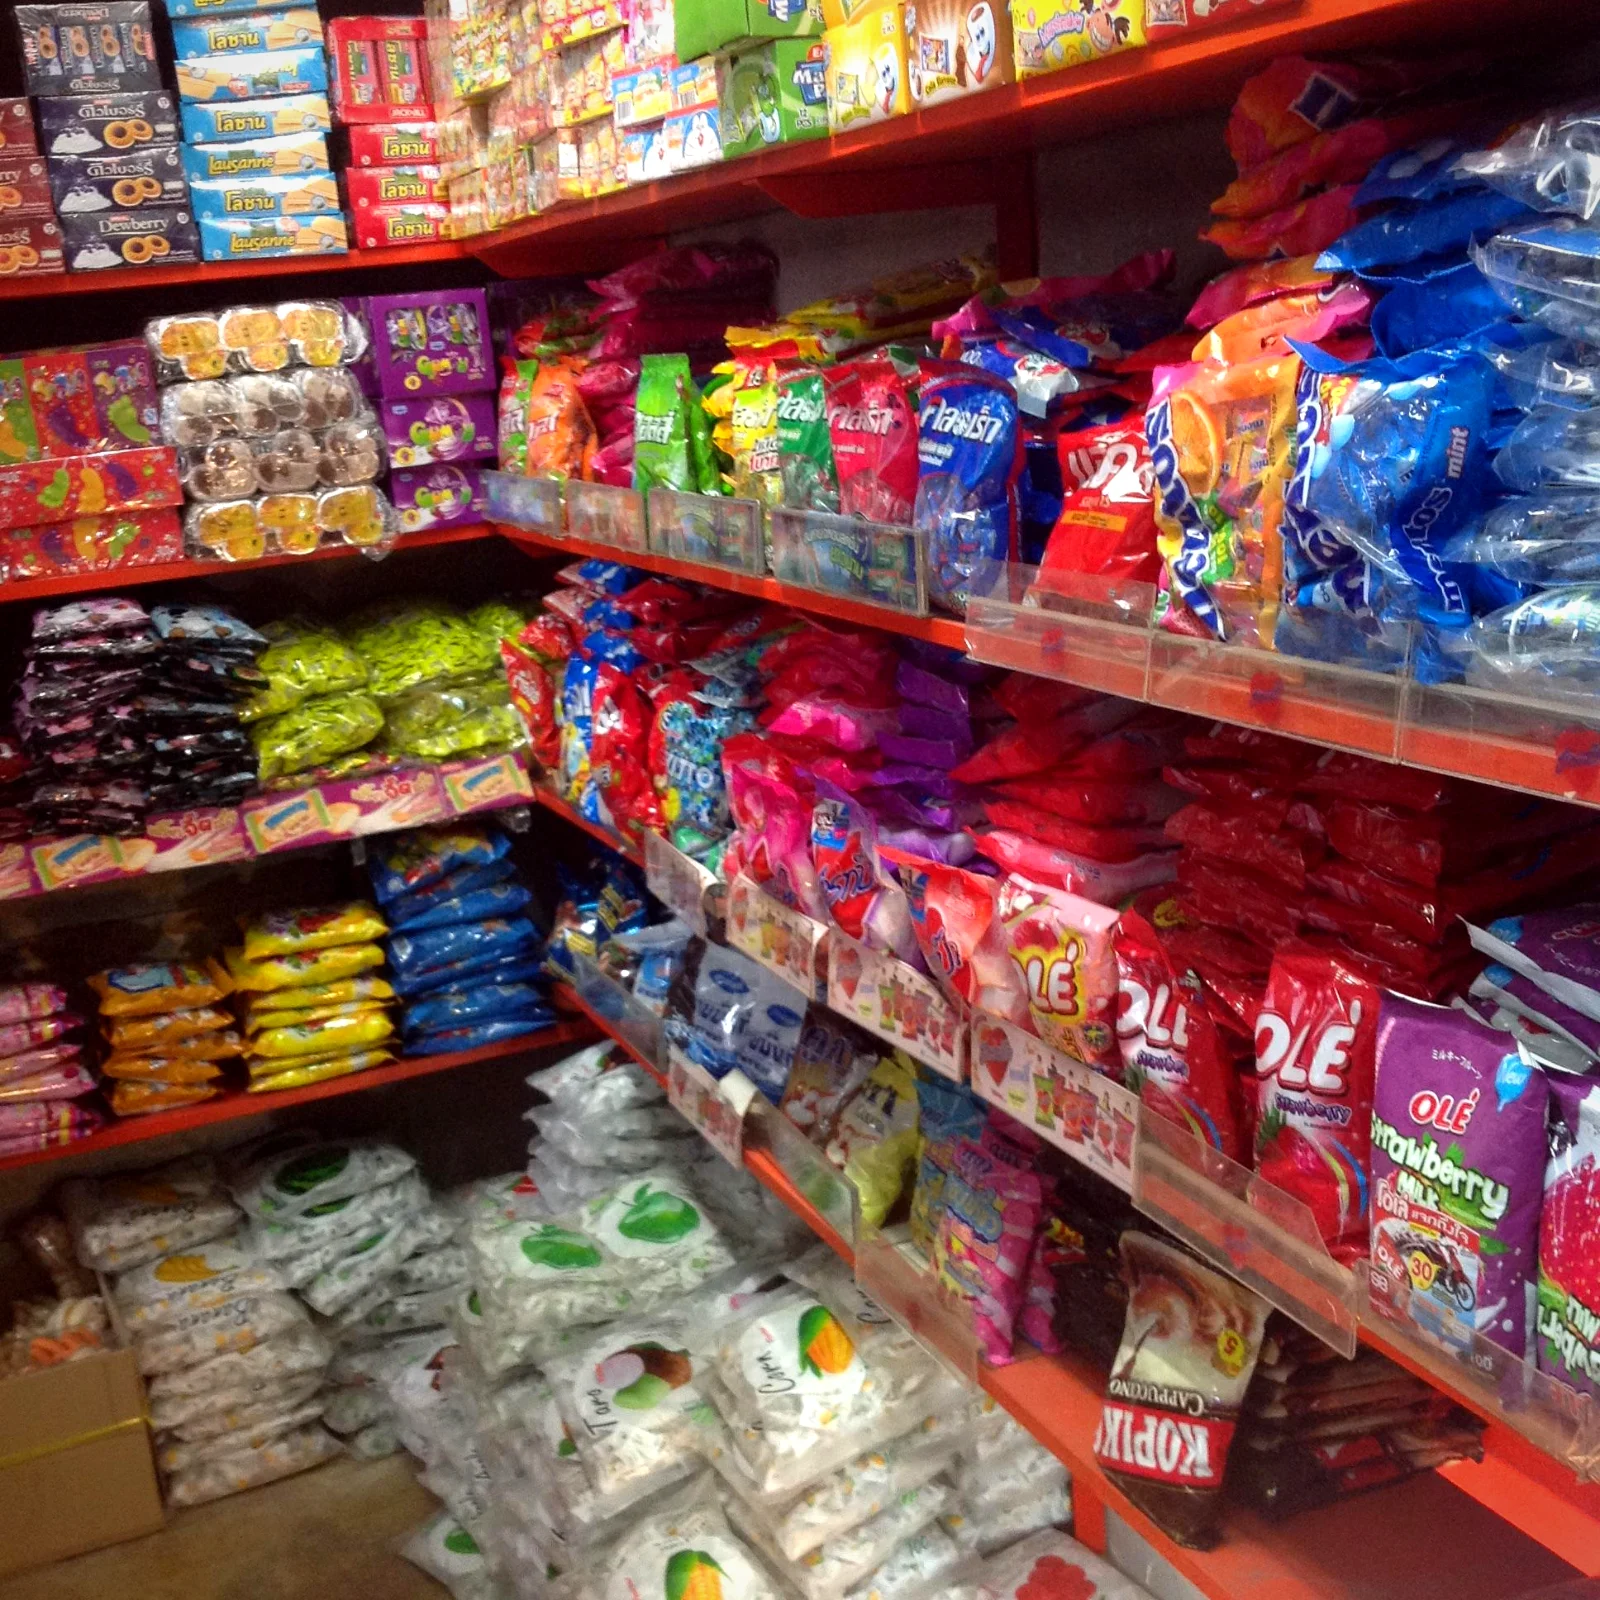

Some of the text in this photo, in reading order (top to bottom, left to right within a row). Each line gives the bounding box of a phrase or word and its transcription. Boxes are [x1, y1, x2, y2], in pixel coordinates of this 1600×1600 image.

[99, 215, 170, 235] Dewberry
[230, 232, 296, 253] Lausanne
[1445, 426, 1470, 480] mint
[1408, 1086, 1482, 1135] OLÉ
[1411, 1256, 1434, 1281] 30
[758, 1349, 796, 1396] Corn
[583, 1387, 618, 1439] Taro
